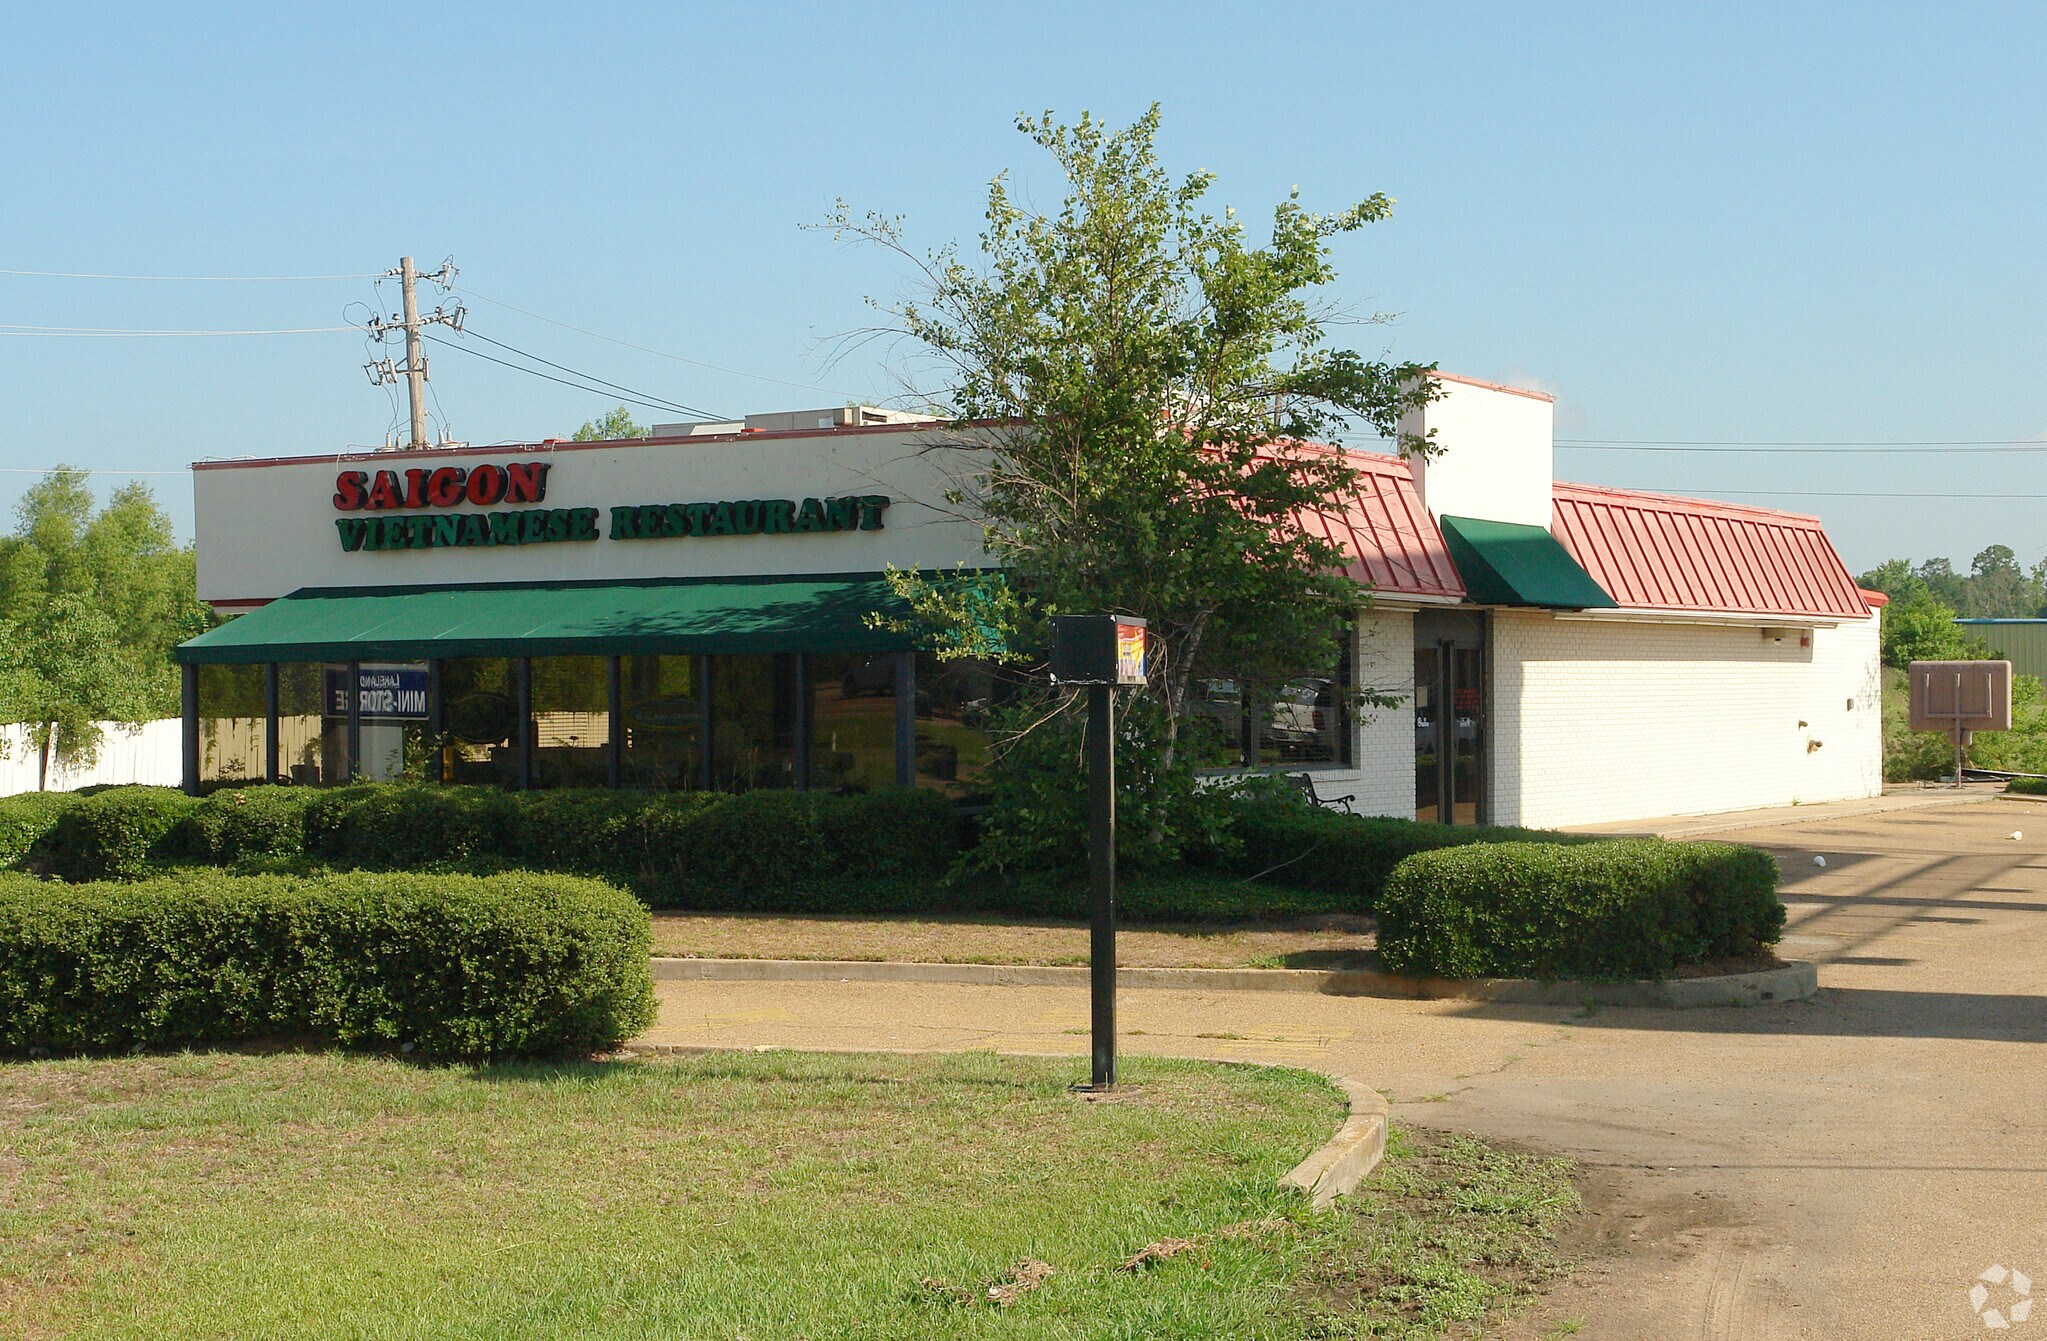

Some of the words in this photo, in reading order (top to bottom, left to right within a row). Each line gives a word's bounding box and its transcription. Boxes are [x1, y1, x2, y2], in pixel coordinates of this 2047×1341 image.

[333, 463, 551, 511] SAIGON
[335, 507, 599, 552] VIETNAMESE
[609, 495, 890, 541] RESTAURANT
